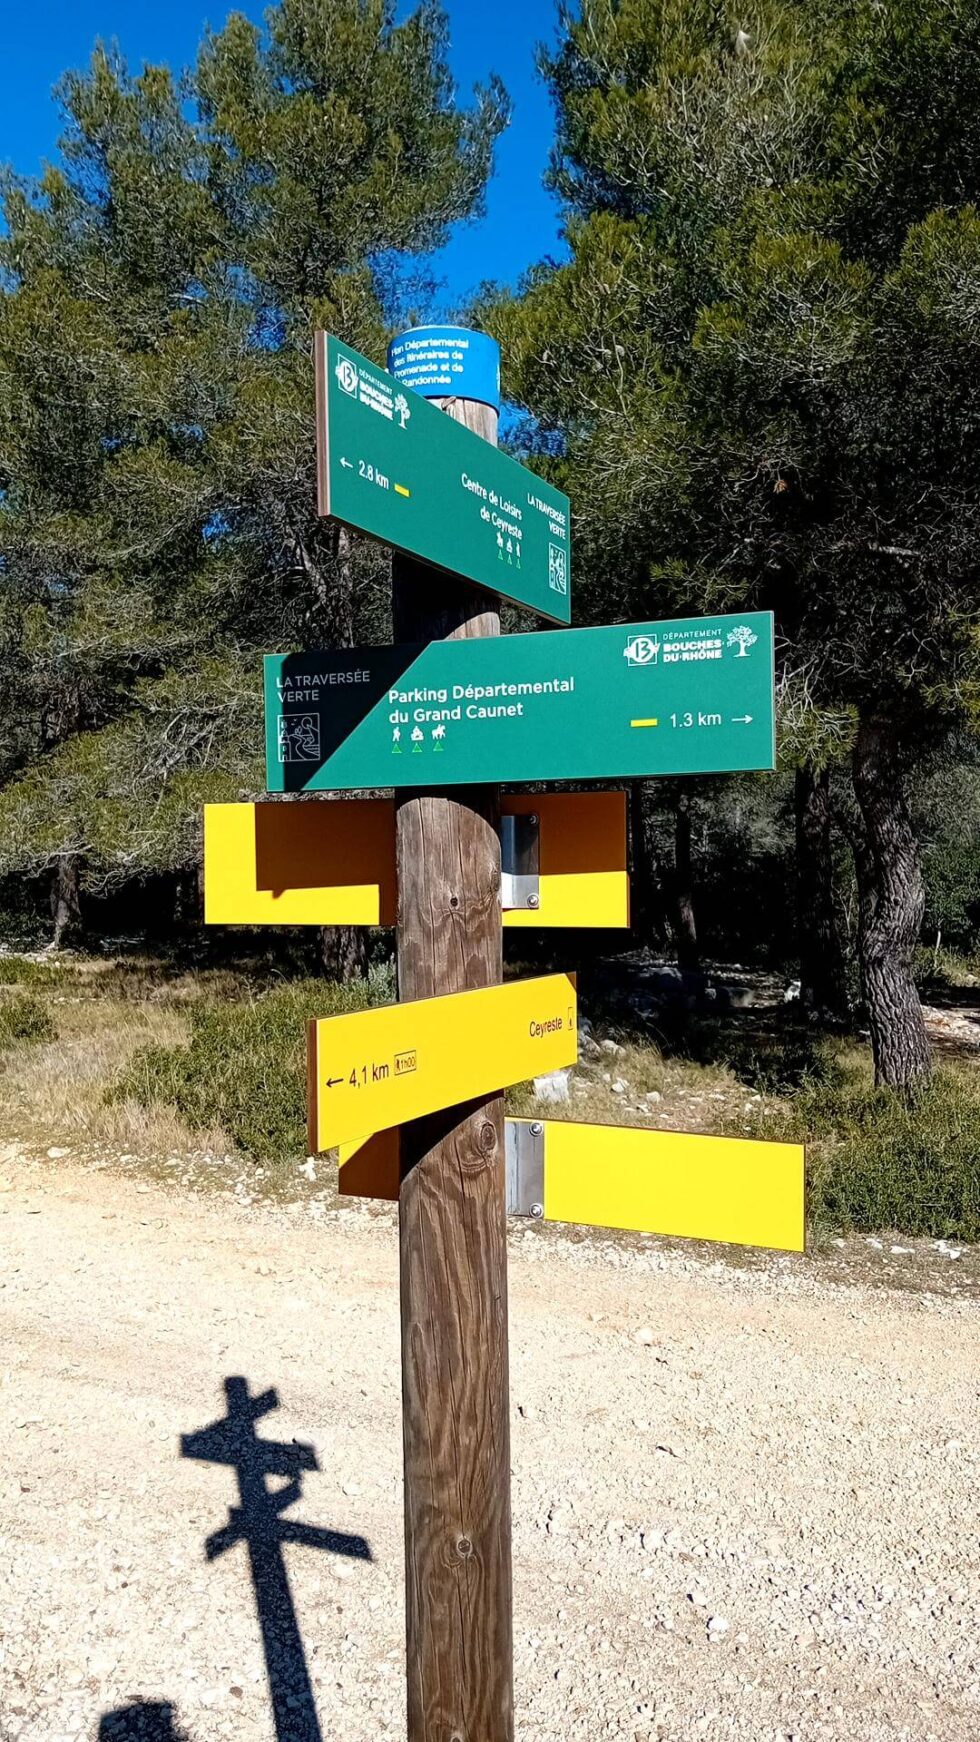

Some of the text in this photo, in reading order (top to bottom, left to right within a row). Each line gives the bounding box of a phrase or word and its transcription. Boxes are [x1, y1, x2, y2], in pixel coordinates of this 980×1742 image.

[405, 338, 469, 351] Départemental
[394, 350, 464, 368] des Itinéraires de
[393, 362, 464, 379] Promenade et de
[358, 459, 390, 490] 2.8 km
[461, 472, 522, 521] Centre de Loisirs
[527, 492, 566, 526] LA TRAVERSÉE
[480, 505, 522, 540] de Ceyreste
[548, 520, 566, 540] VERTE
[662, 628, 722, 641] DÉPARTEMENT
[276, 668, 370, 688] LA TRAVERSÉE
[277, 689, 320, 703] VERTE
[388, 676, 575, 703] Parking Départemental
[389, 702, 524, 724] du Grand Caunet
[669, 711, 722, 728] 1.3 km
[529, 1016, 563, 1039] Ceyreste
[349, 1061, 389, 1089] 4,1 km
